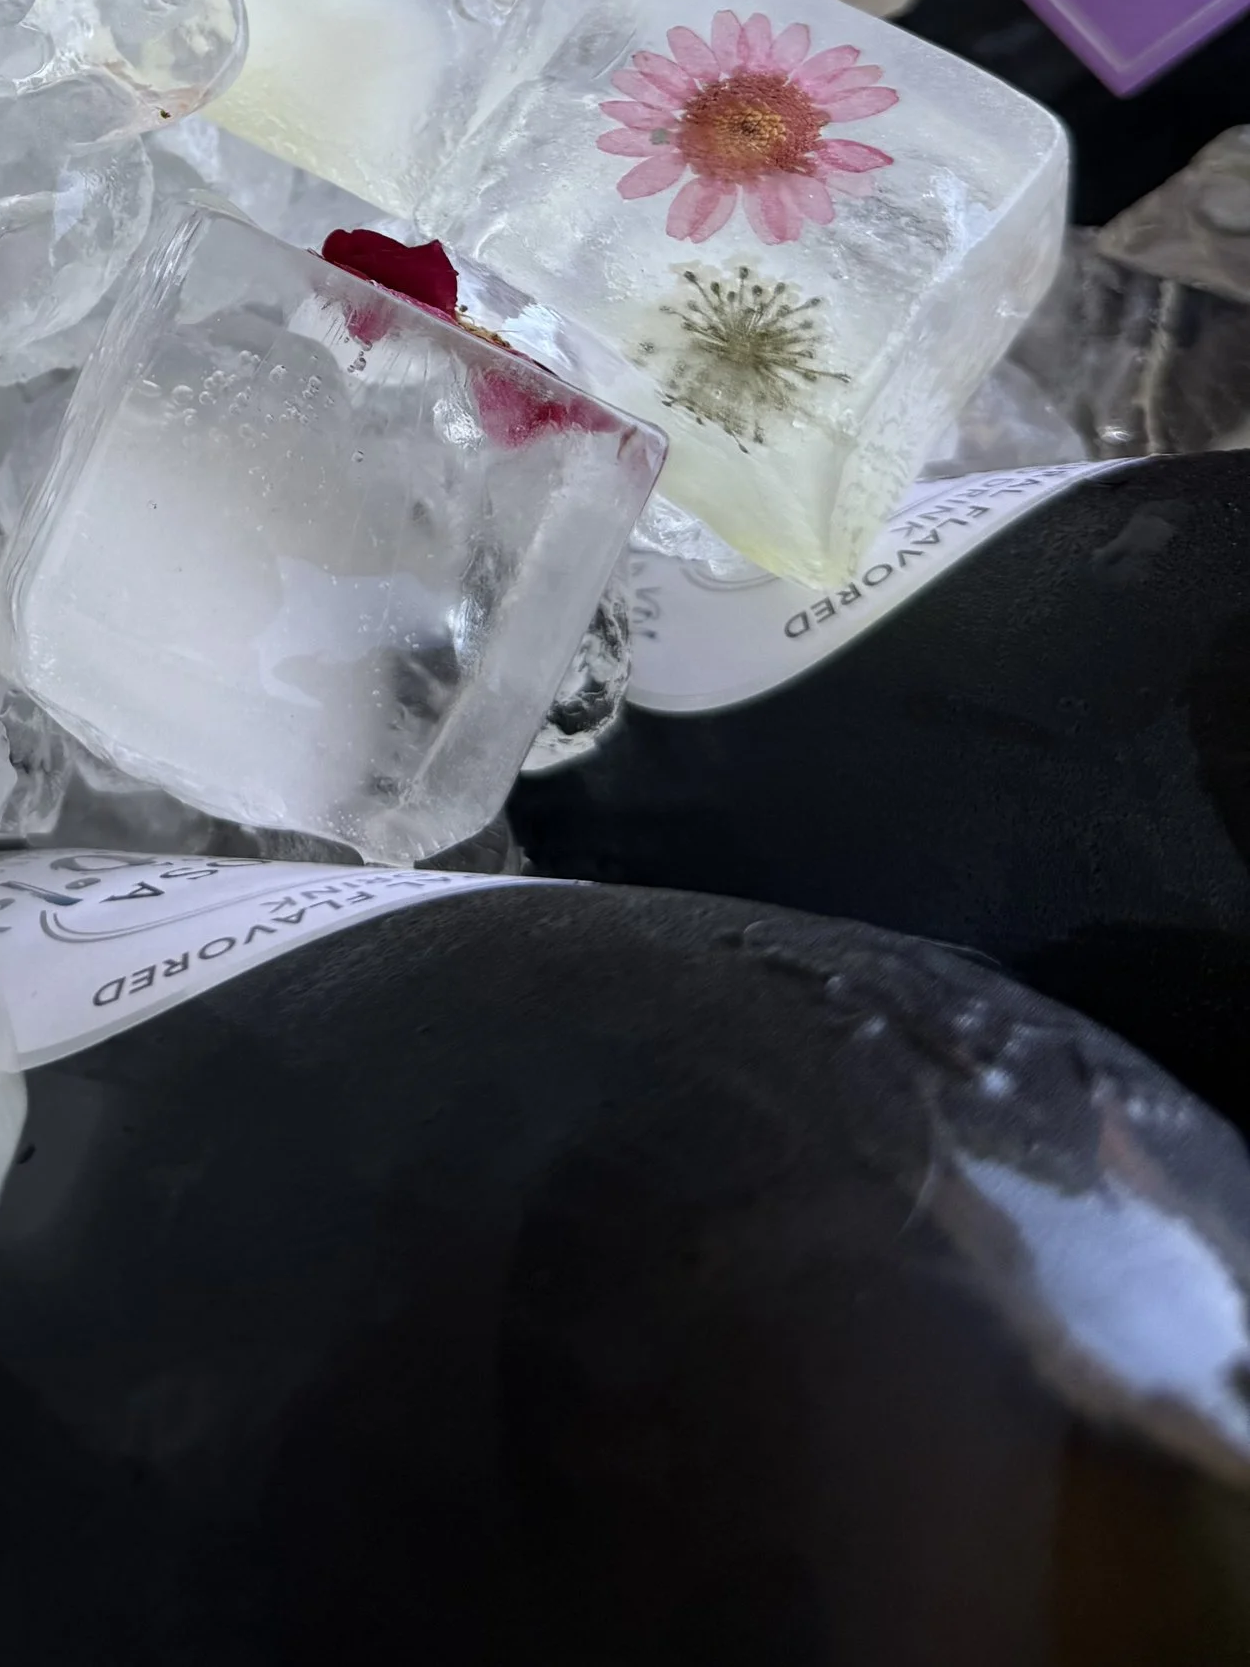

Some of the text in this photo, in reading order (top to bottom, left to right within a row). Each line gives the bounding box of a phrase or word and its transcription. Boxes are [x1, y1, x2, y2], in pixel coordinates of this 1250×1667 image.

[890, 478, 1010, 537] DRINK
[784, 504, 991, 639] FLAVORED
[92, 890, 377, 1007] FLAVORED
